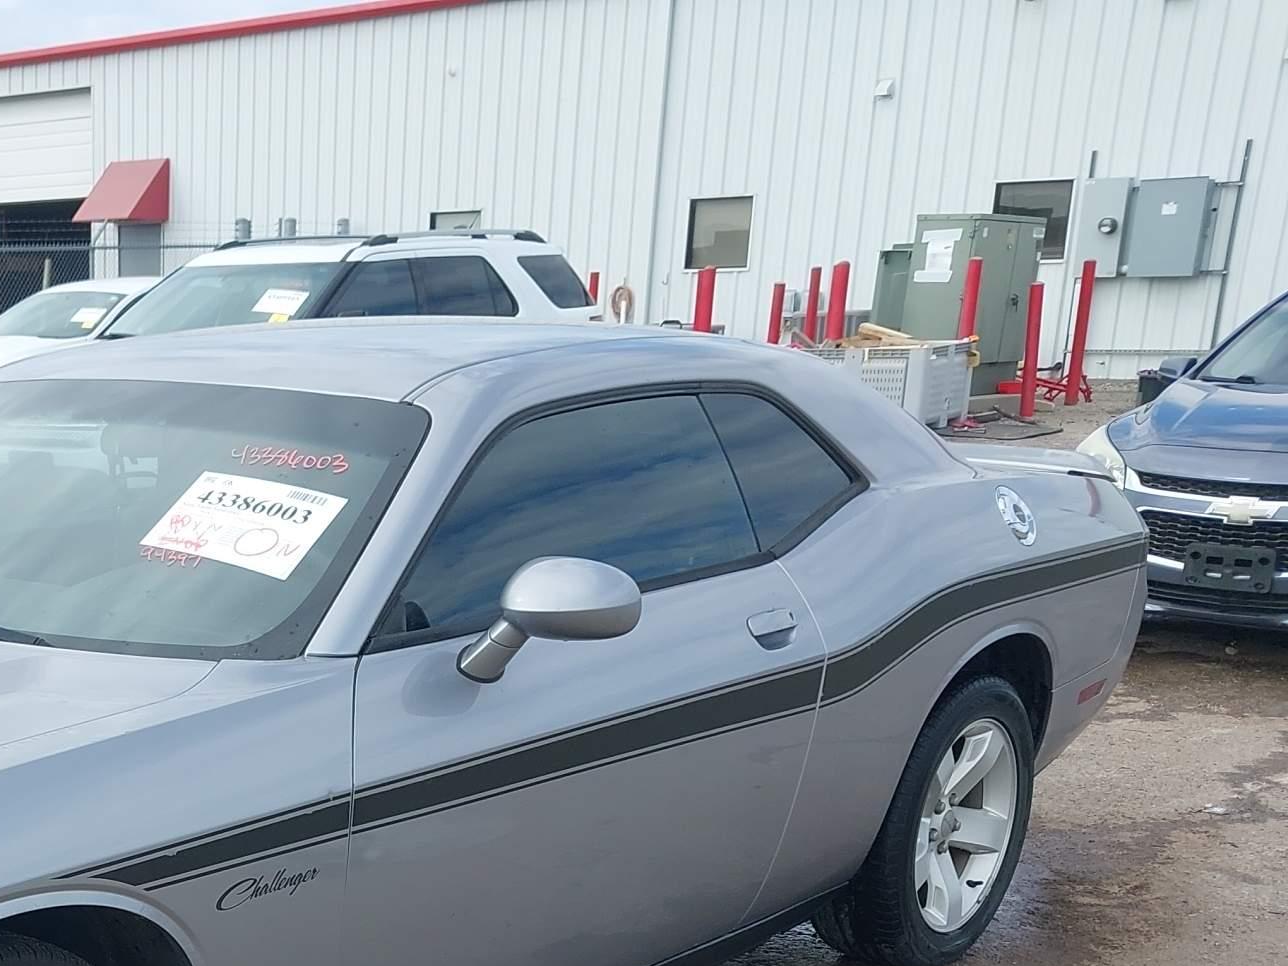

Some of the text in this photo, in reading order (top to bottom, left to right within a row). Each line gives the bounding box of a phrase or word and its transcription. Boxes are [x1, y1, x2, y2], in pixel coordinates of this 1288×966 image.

[231, 444, 350, 474] 43386003
[197, 490, 313, 525] 43386003
[215, 867, 318, 911] Challenger
